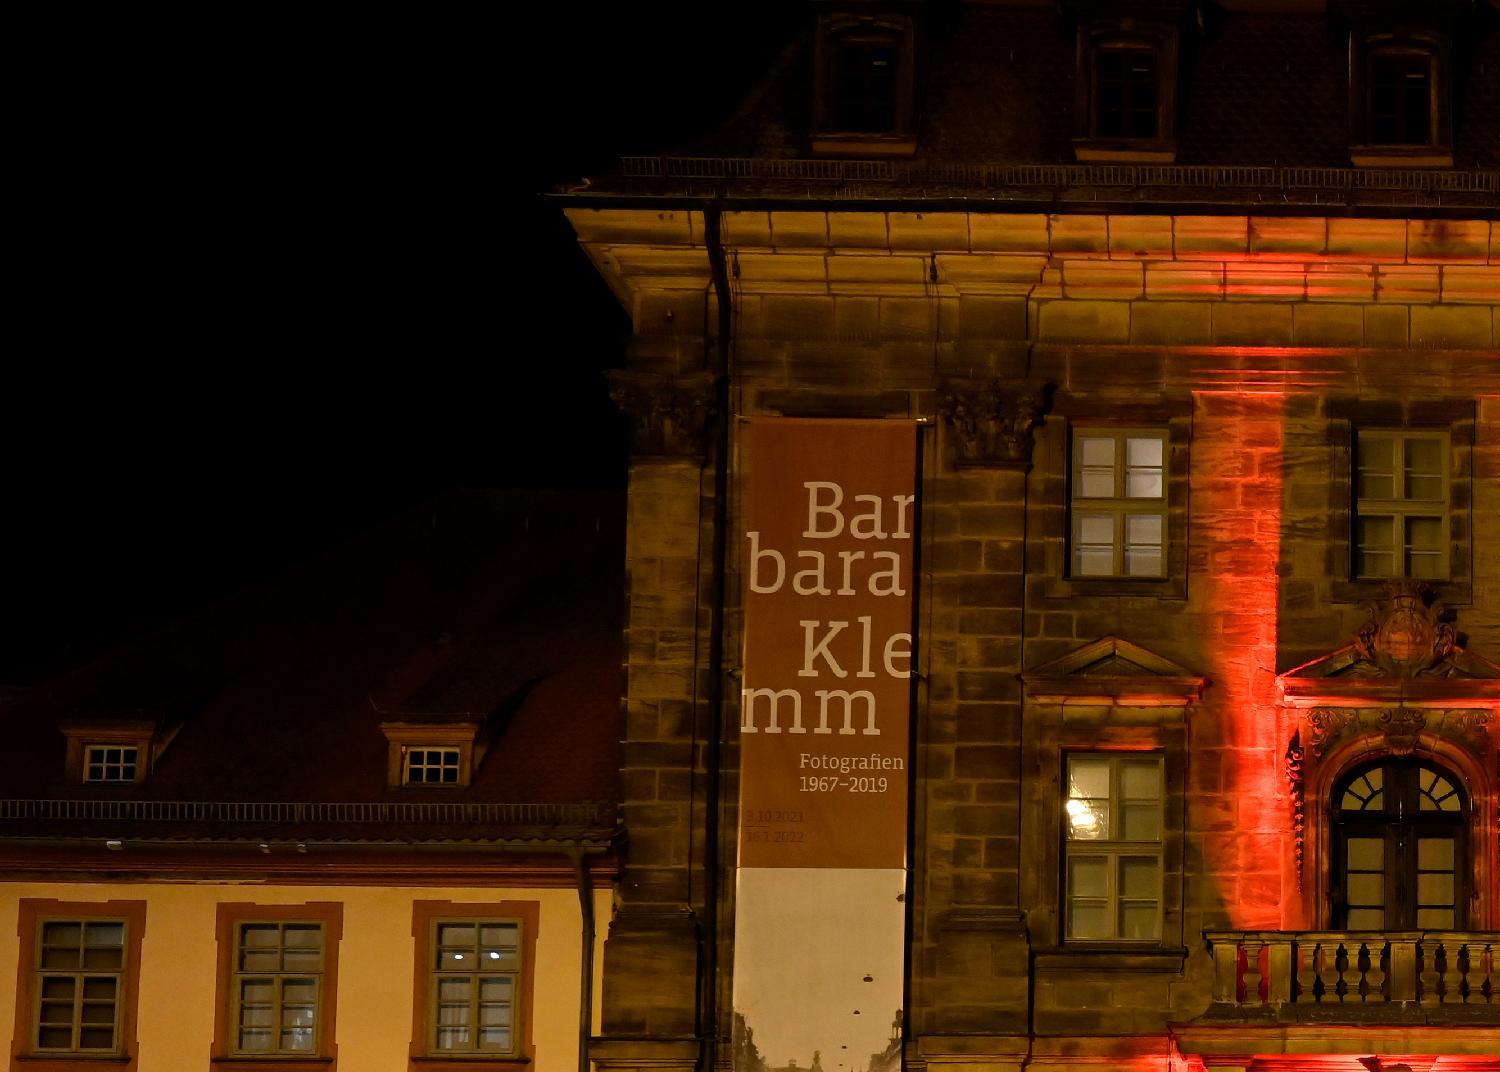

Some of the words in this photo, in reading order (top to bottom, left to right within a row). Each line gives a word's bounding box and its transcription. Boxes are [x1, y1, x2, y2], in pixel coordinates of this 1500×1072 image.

[801, 480, 915, 540] Bar
[746, 530, 906, 597] bara
[796, 615, 913, 679] Kle
[740, 685, 882, 736] mm
[799, 752, 905, 773] Fotografien
